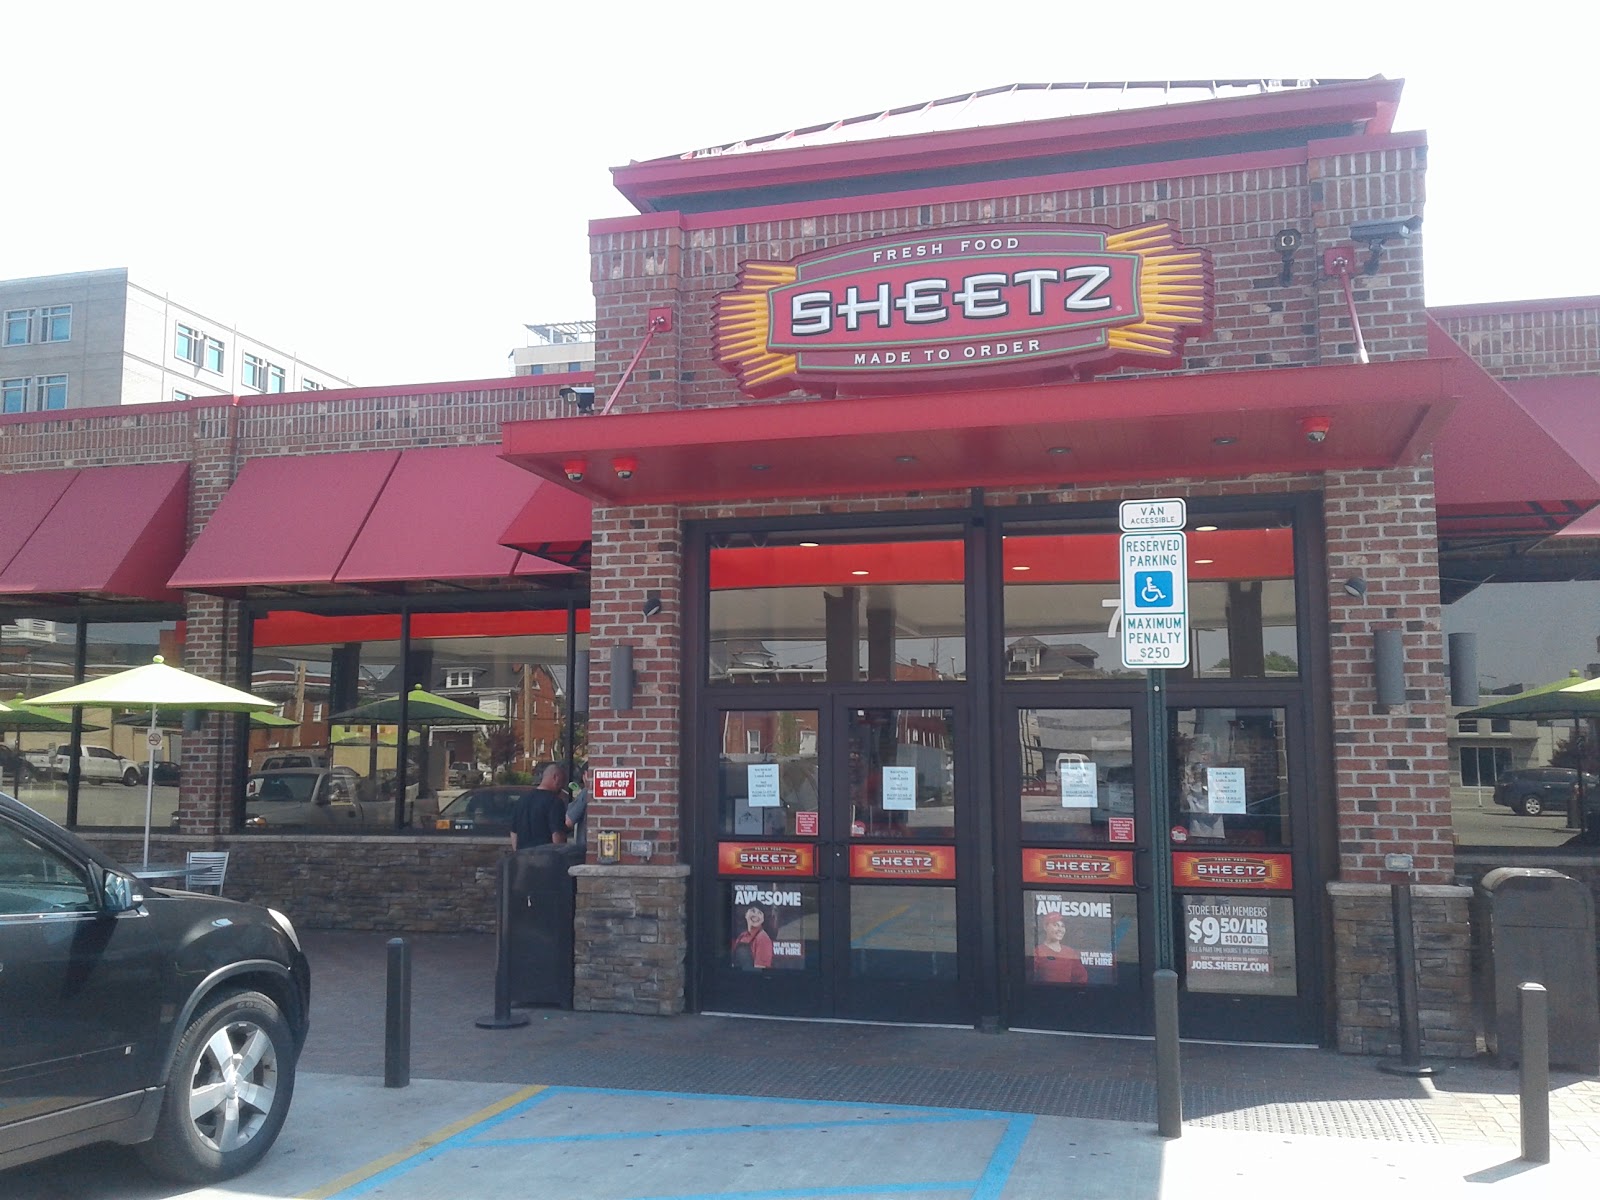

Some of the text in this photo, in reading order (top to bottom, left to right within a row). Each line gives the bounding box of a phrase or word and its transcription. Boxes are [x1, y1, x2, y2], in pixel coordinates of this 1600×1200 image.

[873, 237, 1020, 263] FRESH FOOD
[792, 265, 1112, 335] SHEETZ
[854, 339, 1041, 364] MADE TO ORDER
[1140, 506, 1164, 516] VAN
[1130, 516, 1175, 524] ACCESSIBLE
[1126, 540, 1180, 552] RESERVED
[1130, 554, 1177, 566] PARKING
[1127, 618, 1182, 629] MAXIMUM
[1129, 632, 1181, 644] PENALTY
[1140, 647, 1170, 659] $250
[596, 771, 633, 779] EMERGENCY
[600, 780, 630, 788] SHUT-OFF
[603, 788, 626, 796] SWITCH
[740, 853, 797, 864] SHEETZ
[872, 856, 932, 866] SHEETZ
[1046, 861, 1110, 872] SHEETZ
[1197, 864, 1266, 875] SHEETZ
[735, 890, 802, 906] AWESOME
[1036, 901, 1112, 918] AWESOME
[1188, 905, 1268, 917] STORE TEAM MEMBERS
[1225, 935, 1253, 944] $10.00
[773, 947, 802, 956] WE HIRE
[1080, 957, 1113, 966] WE HIRE
[1191, 961, 1269, 972] JOBS.SHEETZ.COM
